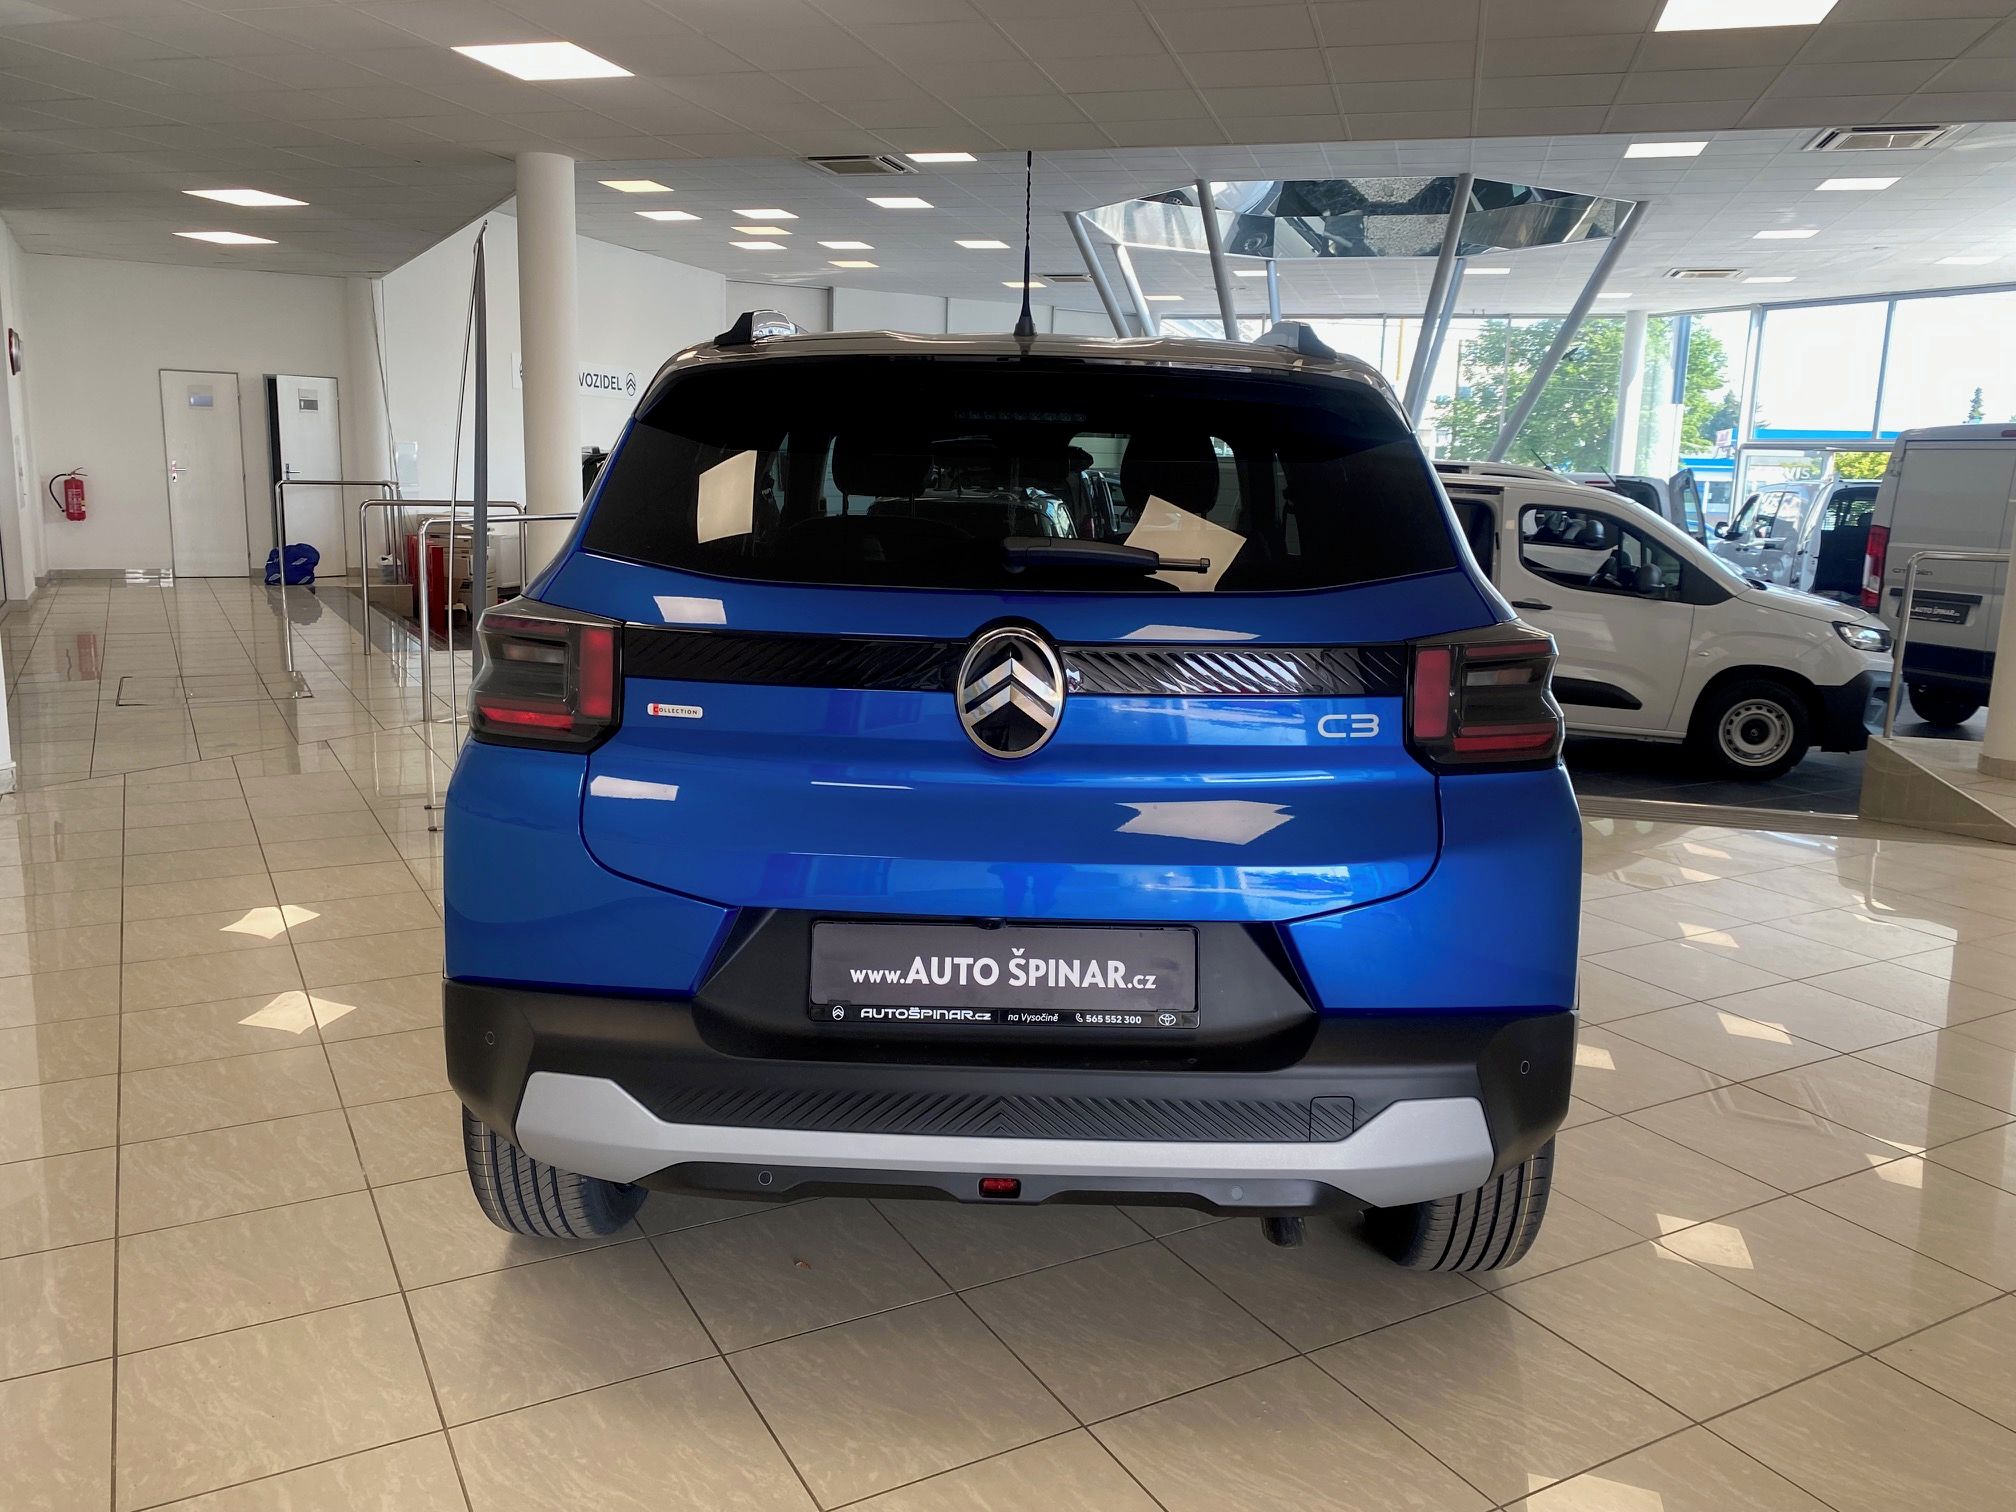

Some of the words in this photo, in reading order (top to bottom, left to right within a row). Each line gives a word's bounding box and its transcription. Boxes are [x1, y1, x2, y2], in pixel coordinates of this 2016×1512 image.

[578, 372, 622, 391] VOZIDEL
[653, 705, 698, 715] COLLECTION
[1317, 713, 1380, 738] C3
[850, 956, 1000, 986] www.AUTO
[1008, 948, 1157, 989] ŠPINAR.cz
[860, 1006, 992, 1021] AUTOŠPINAR.cz
[1007, 1013, 1019, 1022] na
[1021, 1013, 1059, 1024] Vysočině
[1086, 1014, 1104, 1024] 565
[1105, 1015, 1122, 1024] 552
[1123, 1015, 1142, 1024] 300
